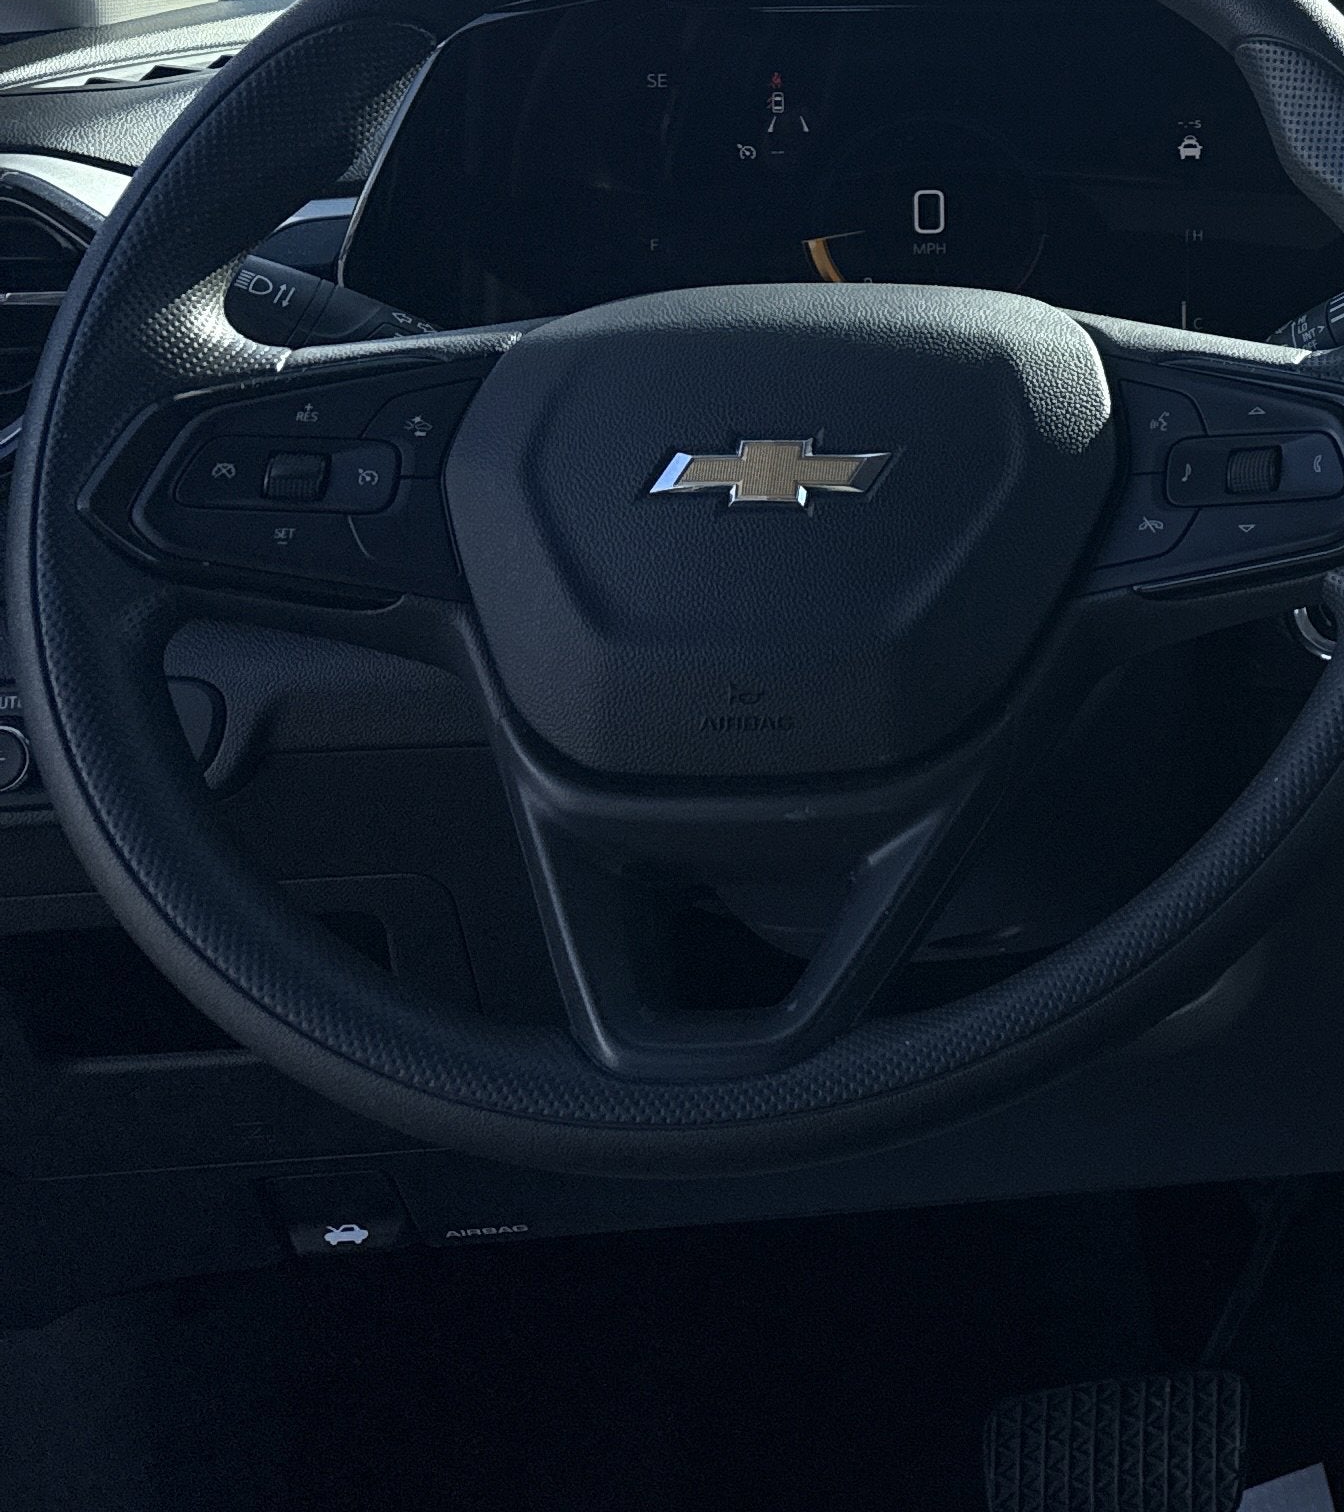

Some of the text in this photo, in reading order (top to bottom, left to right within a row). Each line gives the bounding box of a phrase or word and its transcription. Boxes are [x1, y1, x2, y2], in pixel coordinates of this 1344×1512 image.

[646, 73, 668, 89] SE
[913, 189, 945, 235] 0
[1193, 231, 1204, 241] H
[650, 239, 660, 251] F
[913, 243, 947, 256] MPH
[1302, 329, 1317, 343] INT
[296, 410, 318, 424] RES
[274, 527, 296, 540] SET
[446, 1224, 528, 1239] AIRBAG
